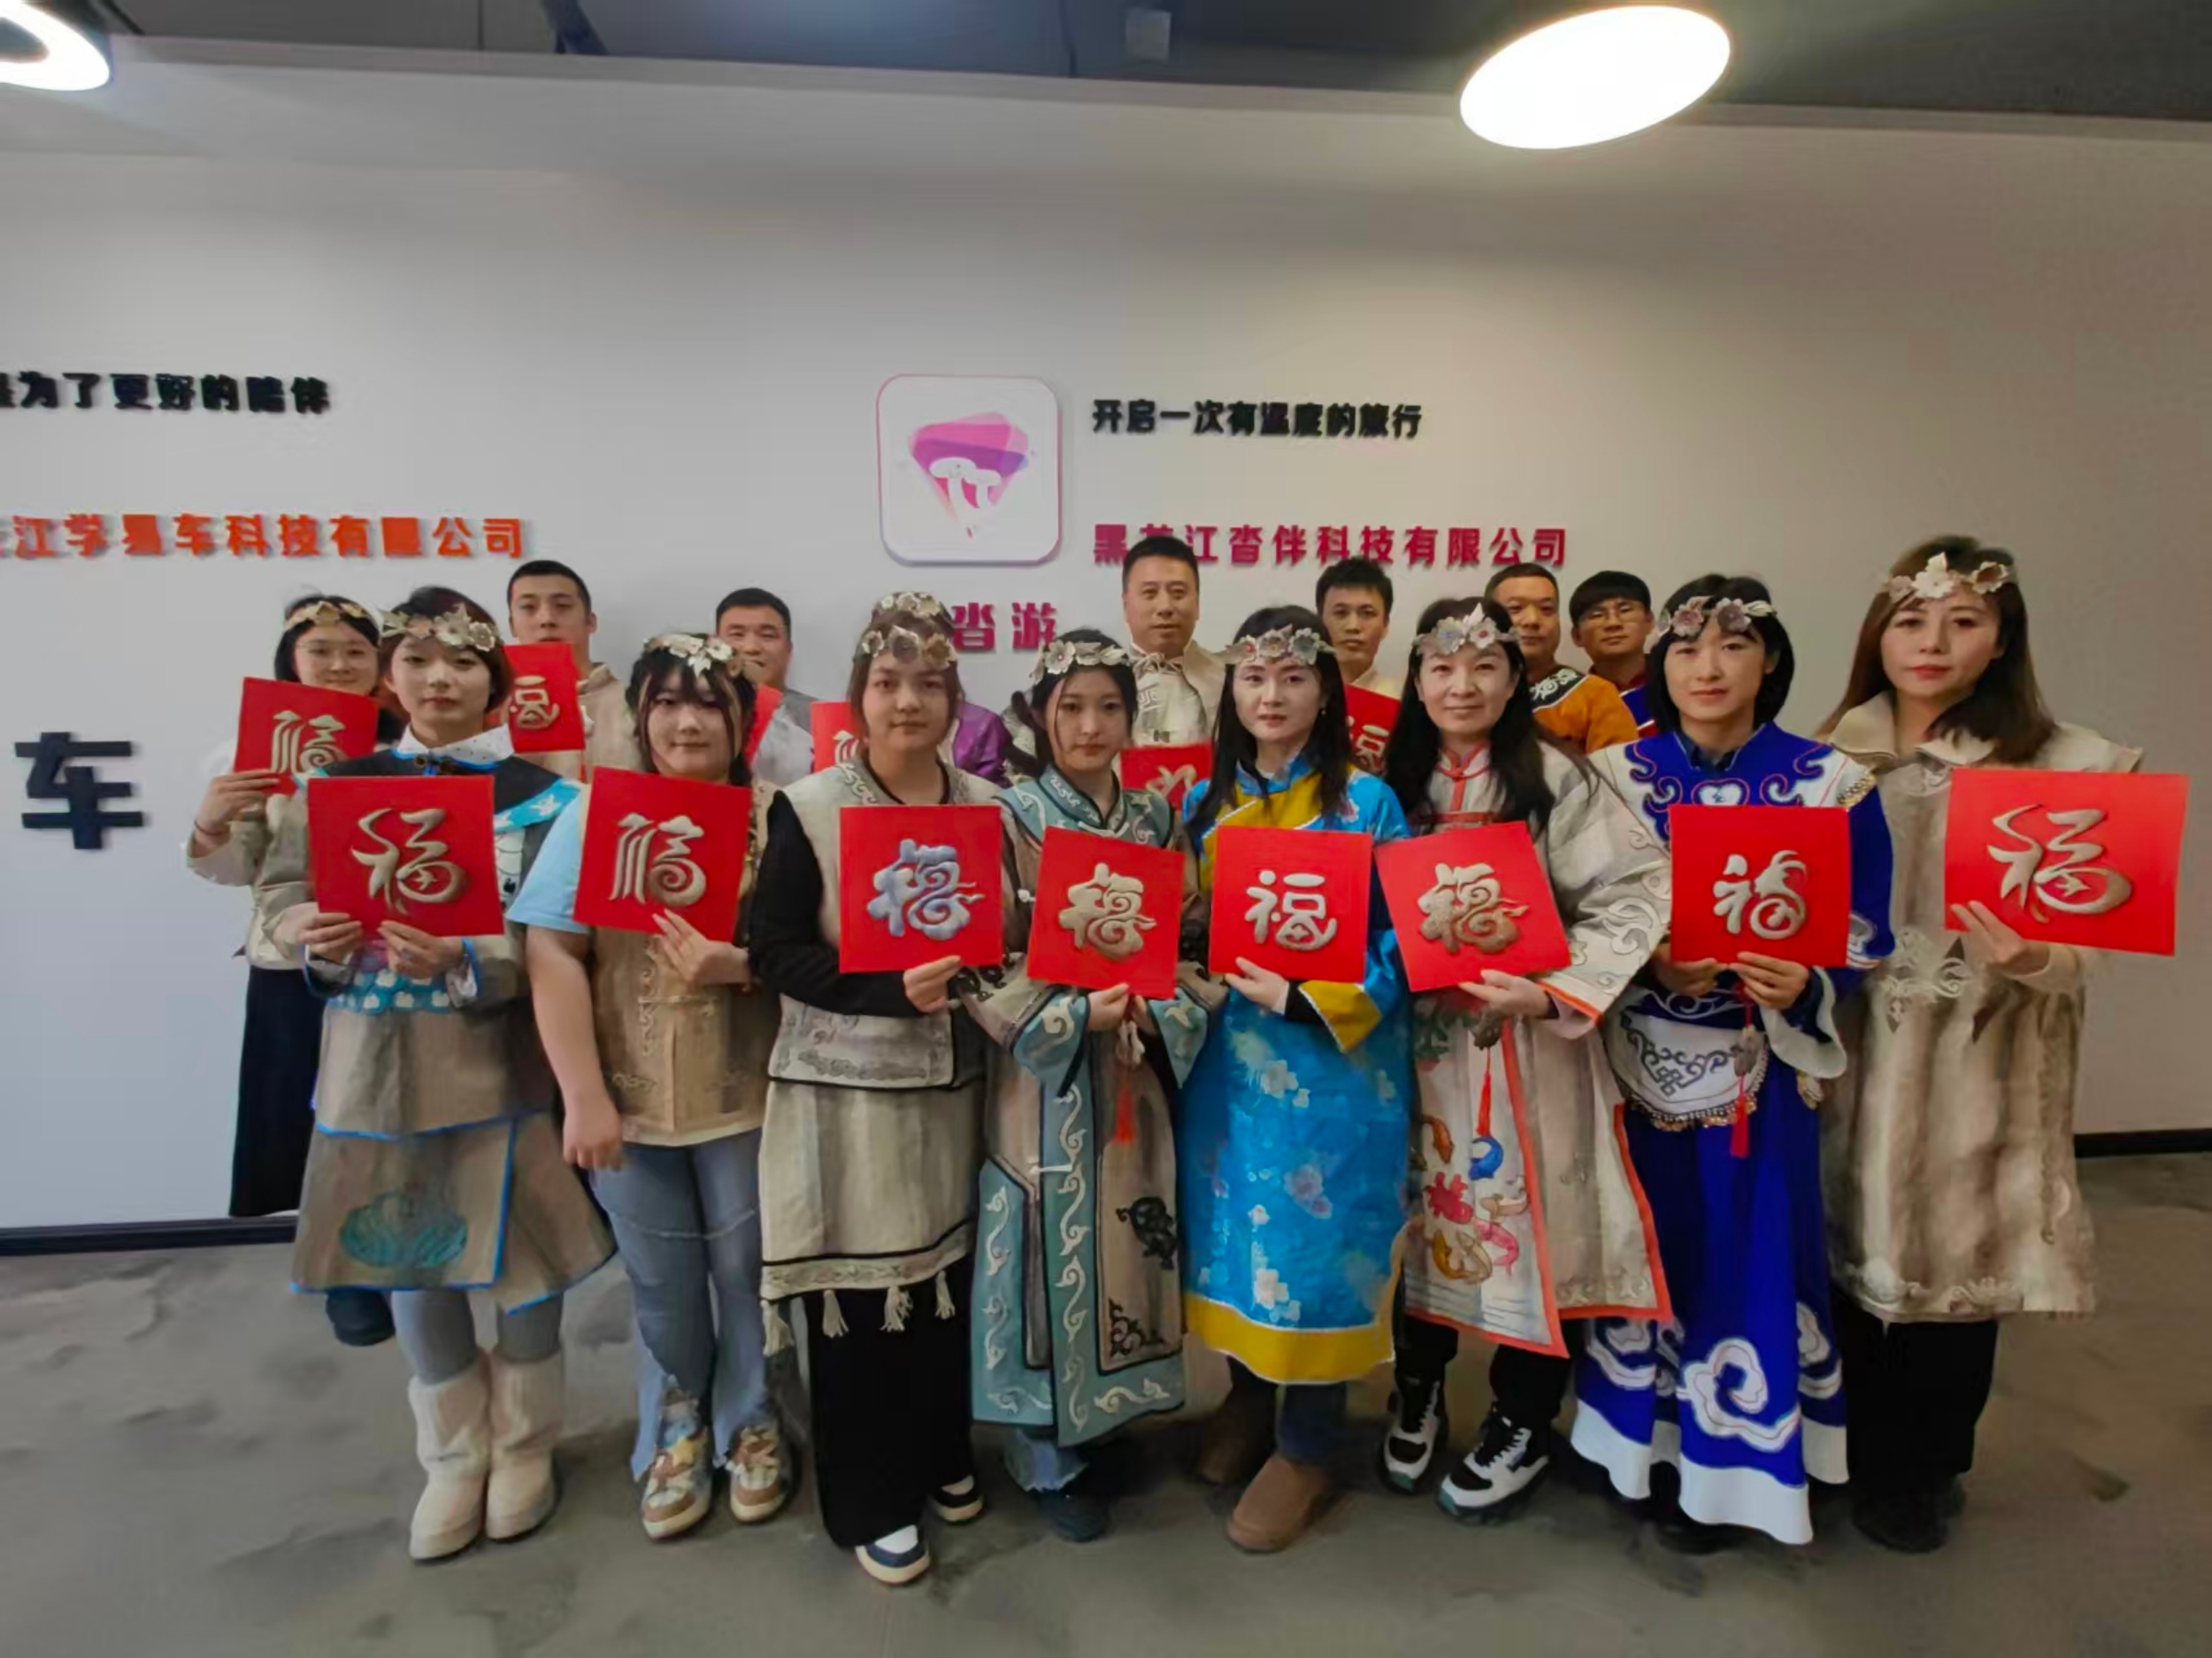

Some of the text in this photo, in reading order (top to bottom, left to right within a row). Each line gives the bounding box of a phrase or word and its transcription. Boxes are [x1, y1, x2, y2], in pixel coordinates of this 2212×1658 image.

[1092, 398, 1422, 438] 开启一次有温度的旅行
[0, 513, 523, 558] 江学易车科技有公司
[1094, 524, 1566, 566] 黑江沓伴科技有限公司
[15, 732, 145, 850] 车
[351, 808, 466, 915] 福
[1712, 849, 1808, 940] 福
[1987, 804, 2132, 923] 福
[1245, 870, 1338, 951] 福
